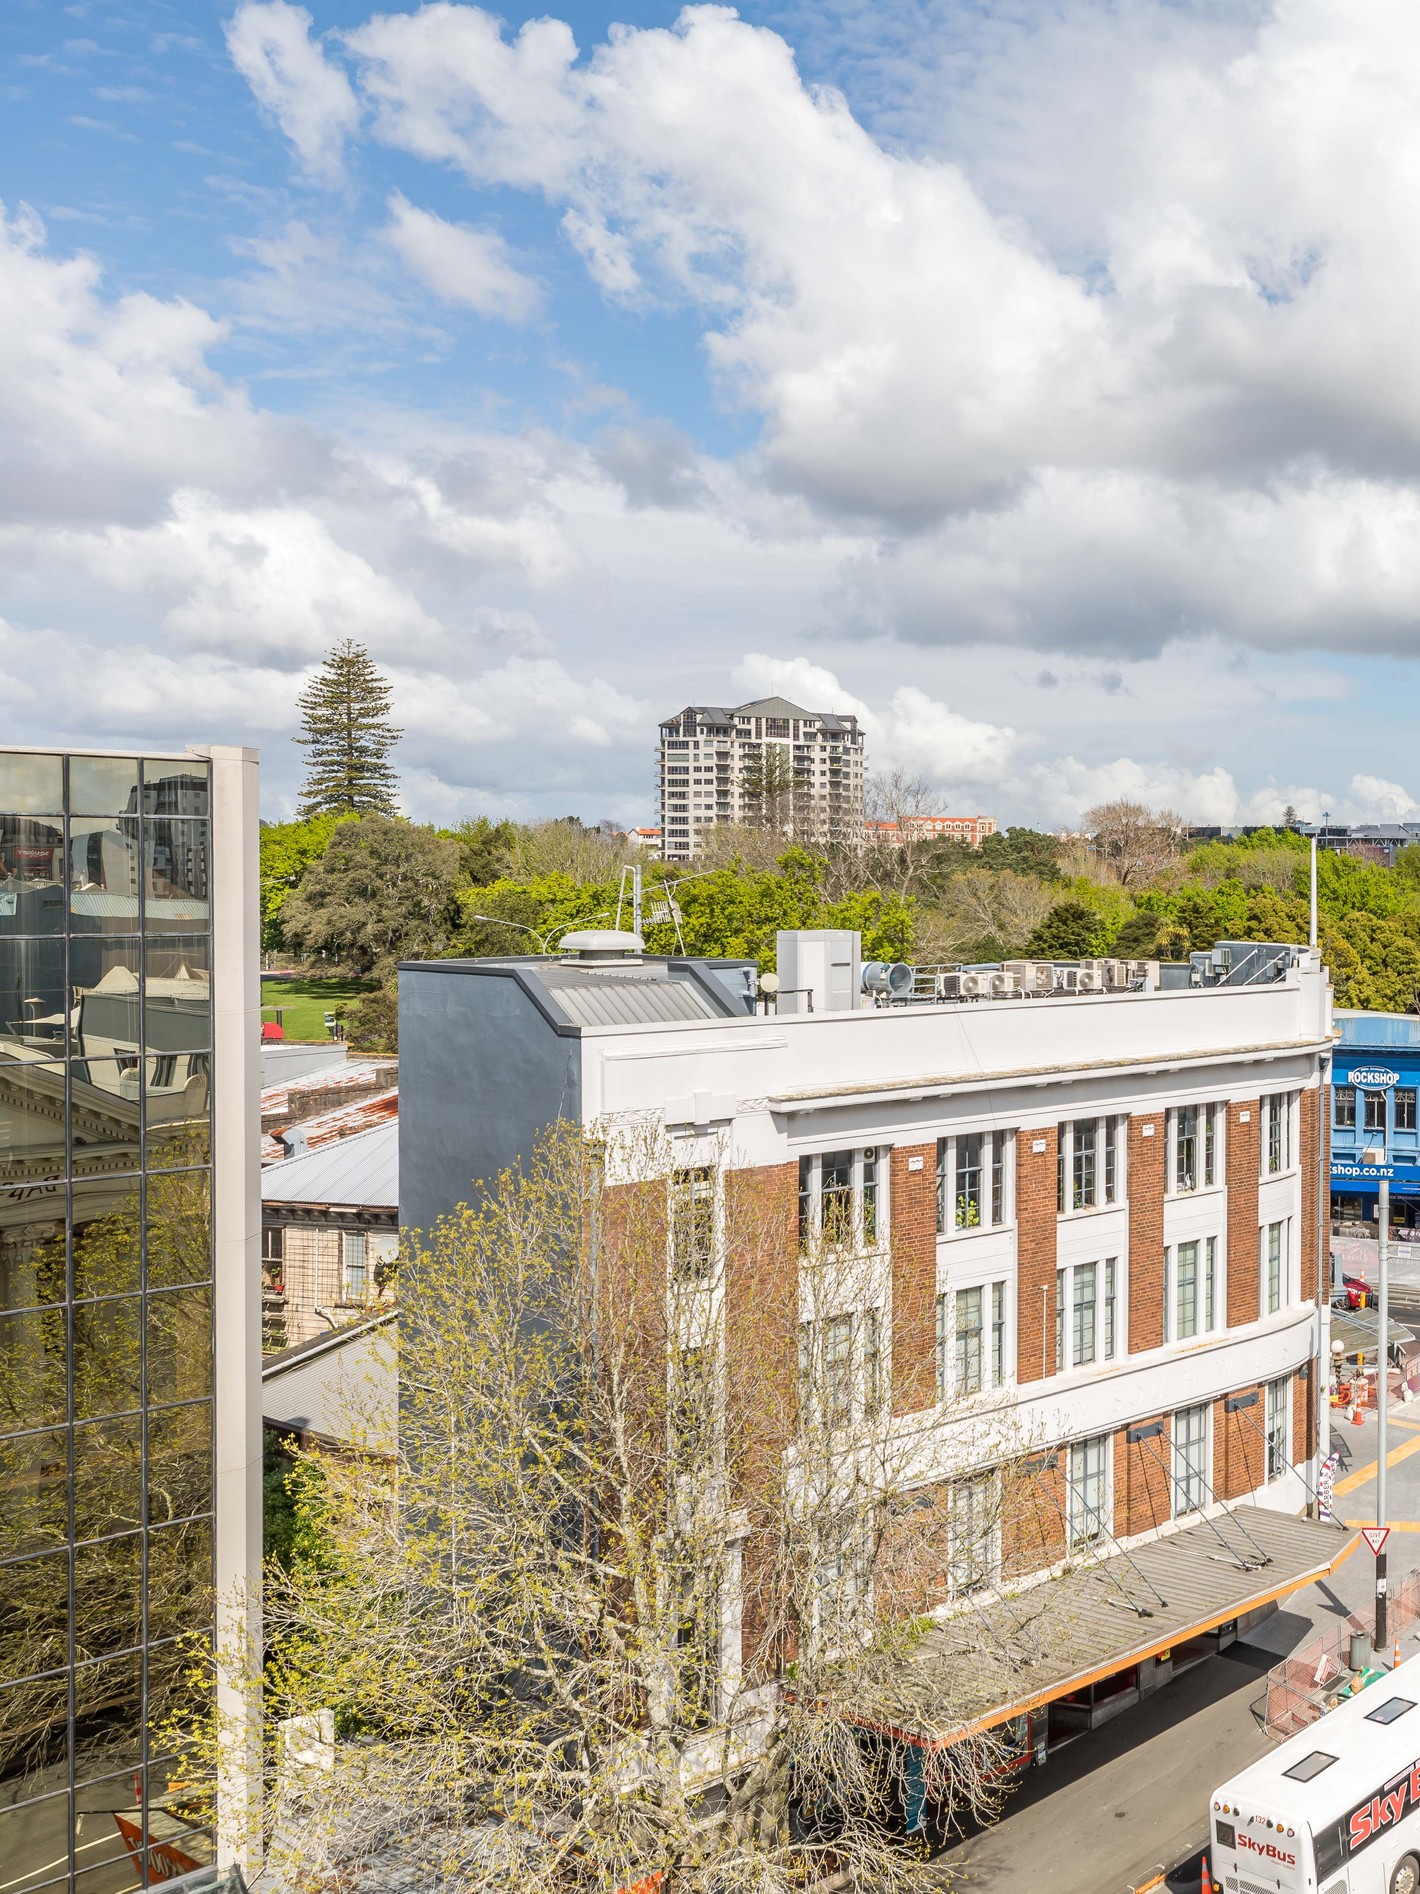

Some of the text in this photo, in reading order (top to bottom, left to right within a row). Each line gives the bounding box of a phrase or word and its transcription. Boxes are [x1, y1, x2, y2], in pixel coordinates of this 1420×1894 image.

[1348, 1072, 1400, 1085] ROCKSHOP
[1254, 1814, 1267, 1825] 132
[1237, 1833, 1296, 1865] SkyBus
